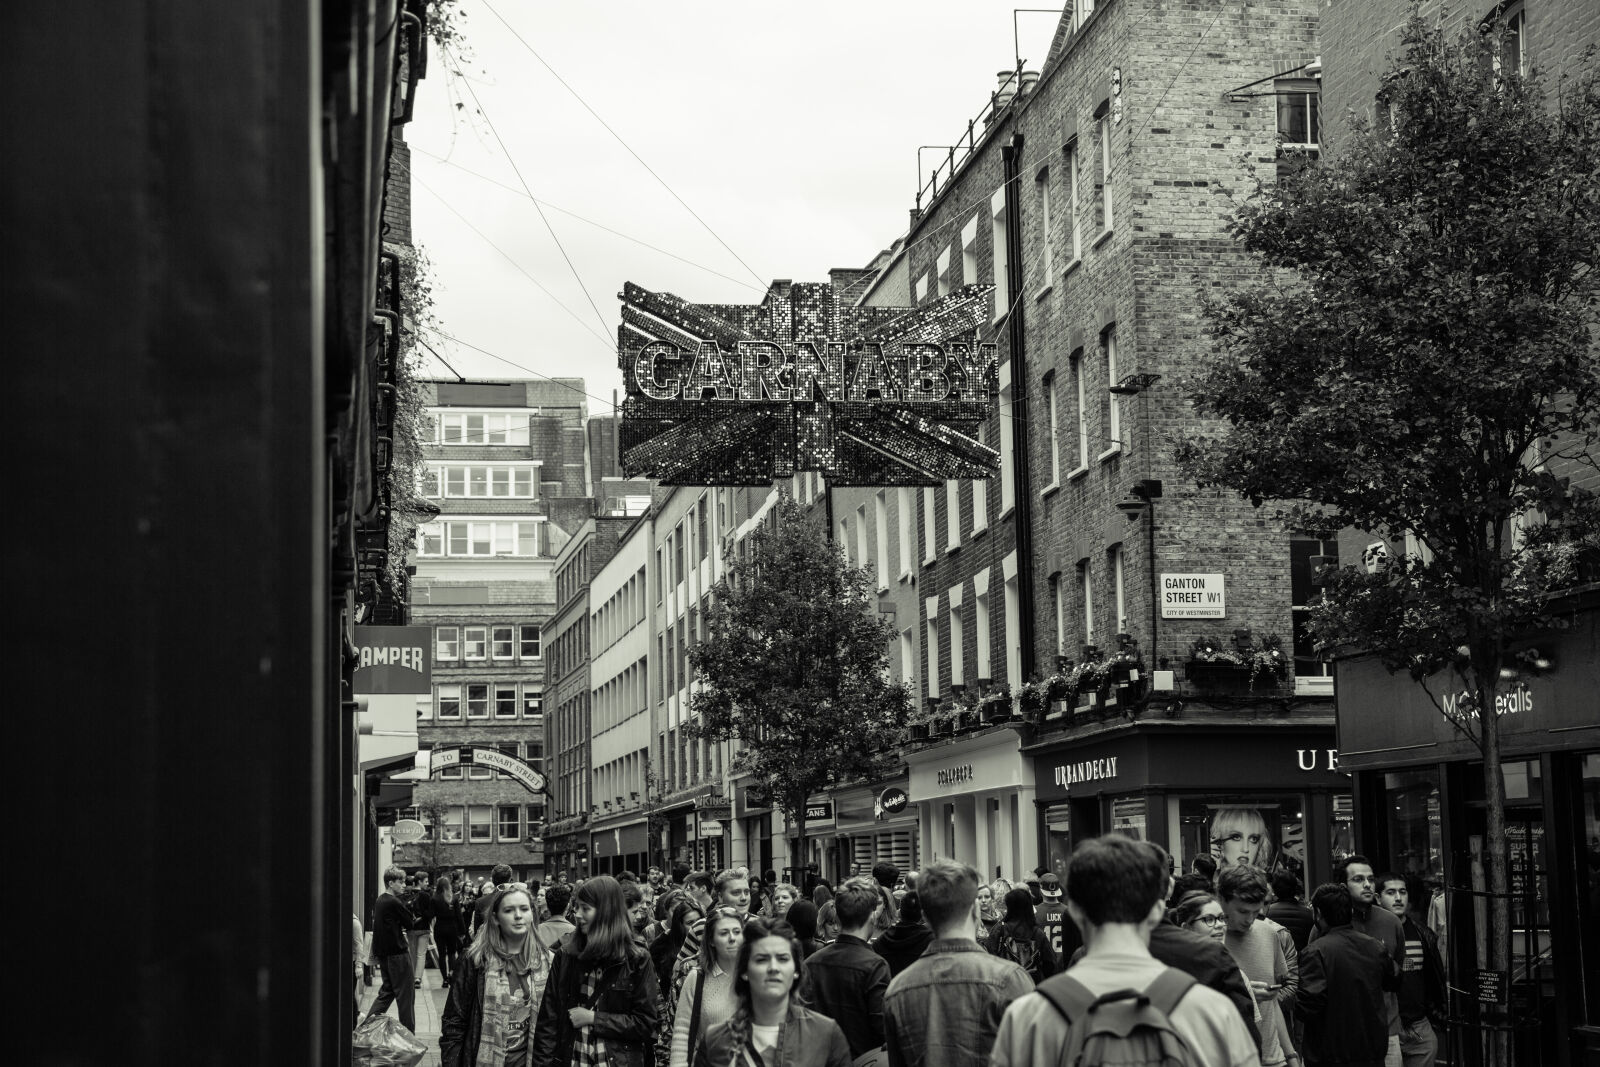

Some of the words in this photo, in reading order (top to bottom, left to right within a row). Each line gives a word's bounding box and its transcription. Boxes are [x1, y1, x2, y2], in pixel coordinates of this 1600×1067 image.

[635, 340, 998, 402] CARNABY
[1165, 578, 1205, 589] GANTON
[1166, 592, 1203, 603] STREET
[1207, 592, 1221, 603] W1
[442, 753, 453, 762] TO
[476, 752, 514, 769] CARNABY
[513, 764, 541, 787] STREET
[806, 808, 827, 818] ANS
[1511, 843, 1539, 851] SUPR
[1046, 913, 1062, 922] LUCK
